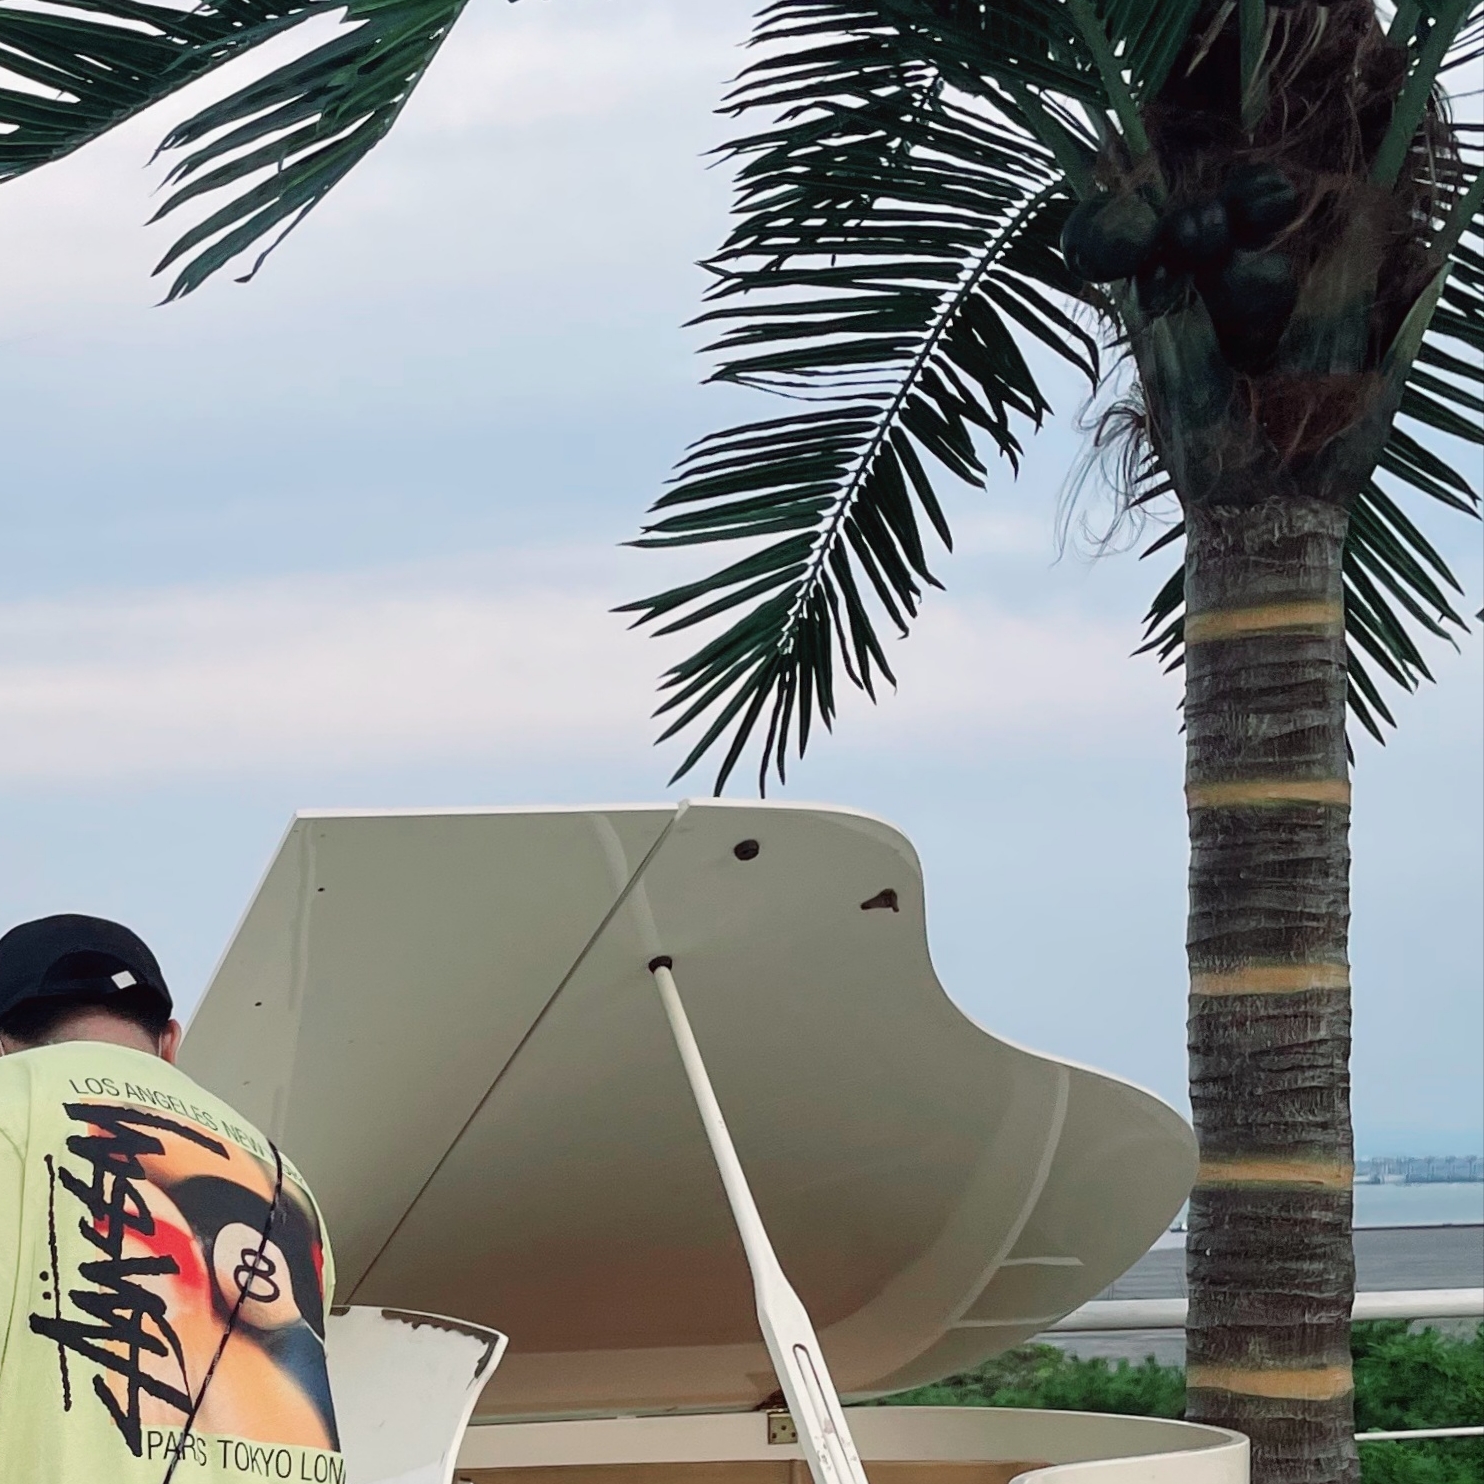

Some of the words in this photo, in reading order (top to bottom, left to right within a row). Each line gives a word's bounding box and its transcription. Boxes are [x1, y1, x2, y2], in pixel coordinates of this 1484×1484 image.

[69, 1077, 120, 1097] LOS
[124, 1082, 219, 1132] ANGELES
[233, 1247, 281, 1304] 8
[217, 1439, 292, 1479] TOKYO
